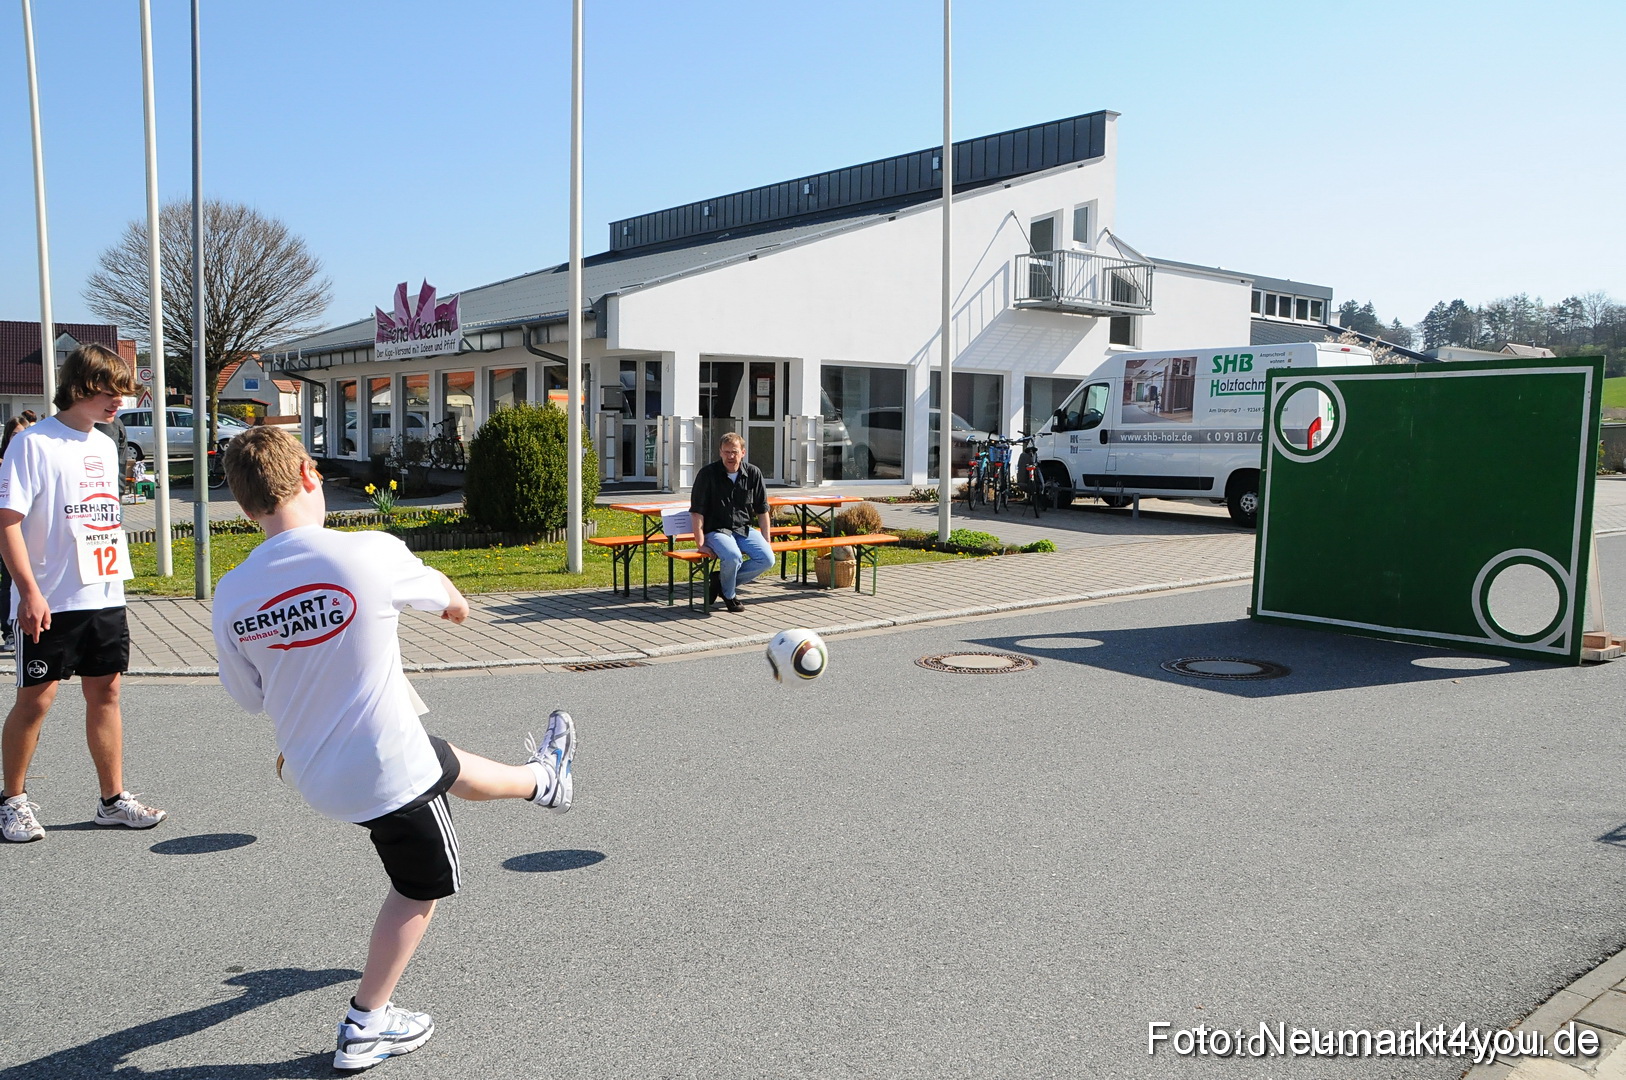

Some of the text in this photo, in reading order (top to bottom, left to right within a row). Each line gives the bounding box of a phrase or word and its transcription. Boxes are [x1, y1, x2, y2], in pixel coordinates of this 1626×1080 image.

[421, 341, 434, 353] Ideen
[435, 341, 443, 351] und
[1211, 354, 1254, 375] SHB
[1210, 378, 1266, 398] Holzfachm
[1120, 432, 1193, 442] www.shb-holz.de
[80, 481, 112, 489] SEAT
[64, 503, 115, 514] GERHART
[85, 533, 109, 541] MEYER
[93, 546, 119, 576] 12
[233, 595, 341, 635] GERHART &
[28, 666, 47, 674] FCN
